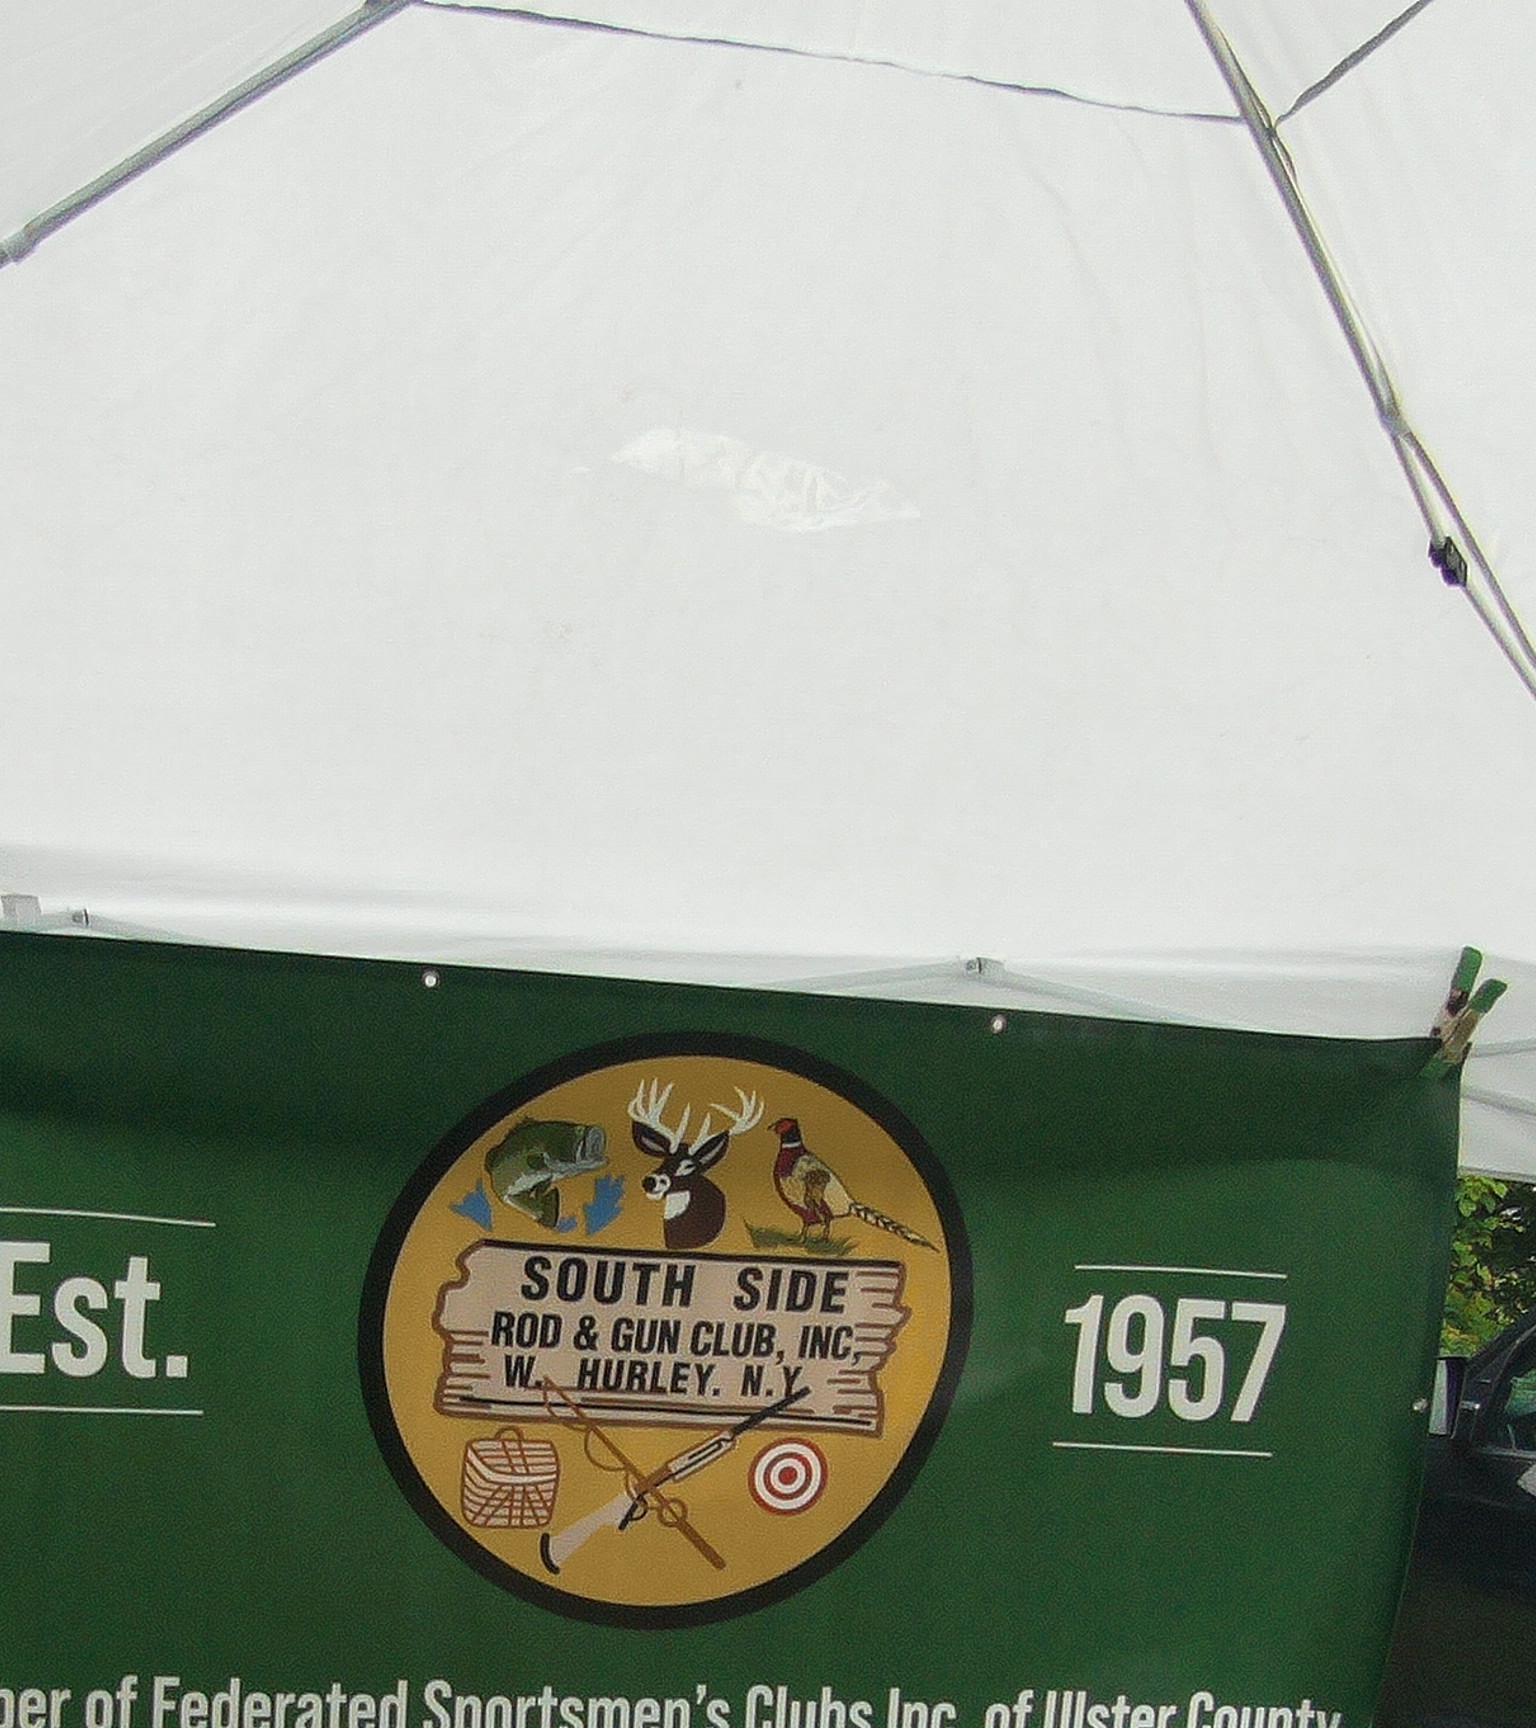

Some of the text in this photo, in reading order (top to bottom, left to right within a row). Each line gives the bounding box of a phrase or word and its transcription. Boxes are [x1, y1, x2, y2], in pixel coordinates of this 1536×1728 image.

[520, 1255, 850, 1314] SOUTH SIDE
[490, 1310, 563, 1349] ROD
[572, 1313, 599, 1352] &
[610, 1316, 682, 1356] GUN
[689, 1320, 786, 1365] CLUB,
[1064, 1294, 1287, 1422] 1957
[503, 1354, 544, 1389] W.
